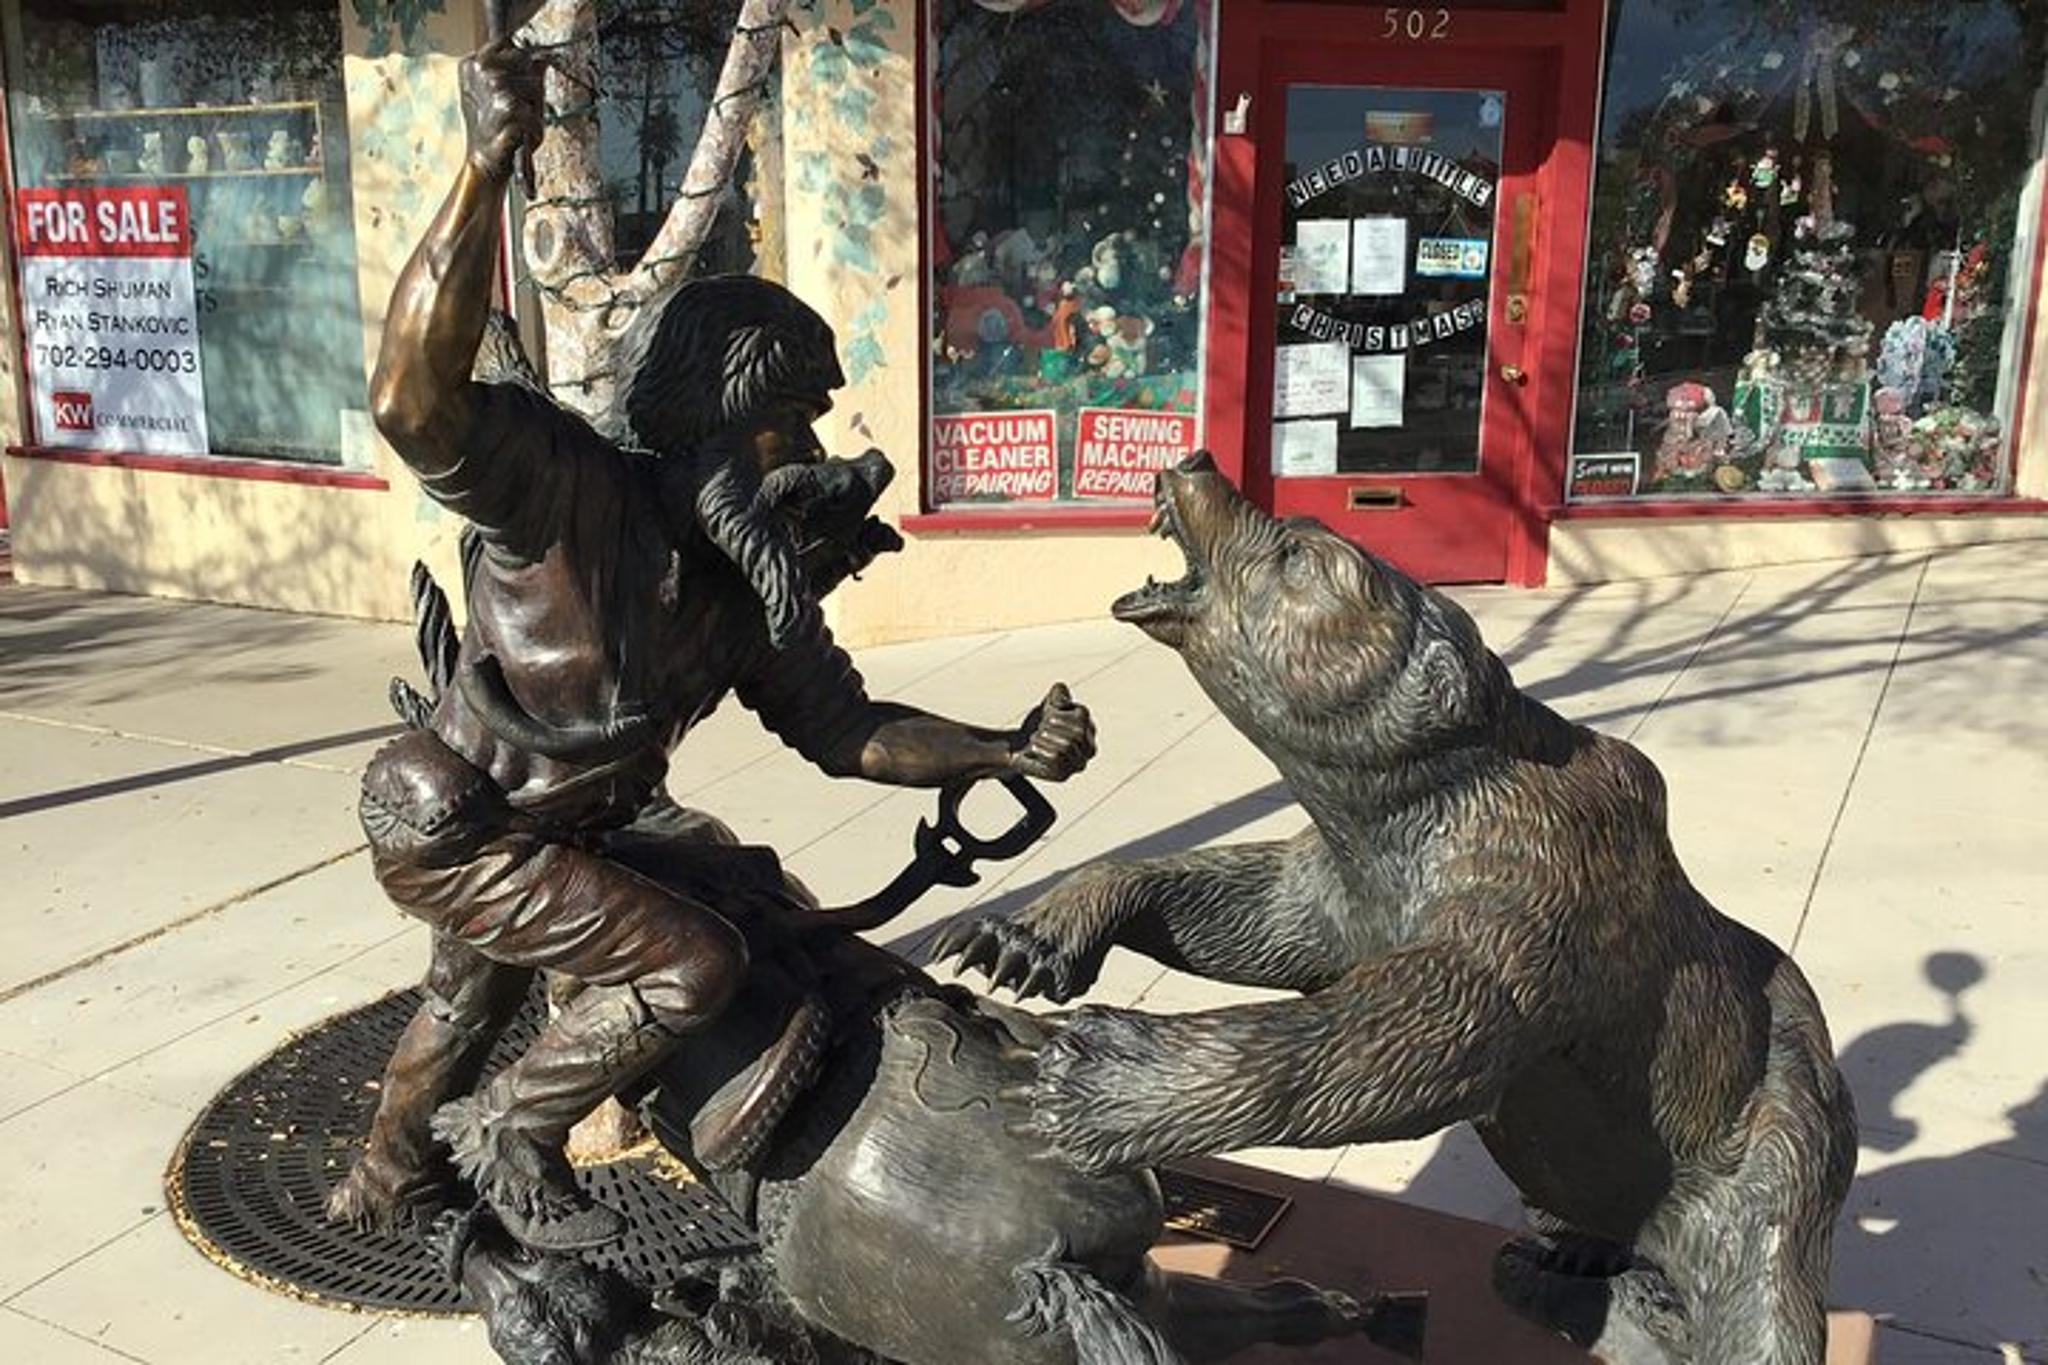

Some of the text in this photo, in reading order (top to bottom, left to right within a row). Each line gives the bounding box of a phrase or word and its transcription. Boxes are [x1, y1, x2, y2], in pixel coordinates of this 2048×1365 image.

[1380, 8, 1449, 38] 502
[1287, 152, 1362, 205] NEED
[27, 201, 89, 243] FOR
[97, 201, 180, 243] SALE
[46, 278, 171, 299] RICH SHUMAN
[36, 310, 189, 335] RYAN STANKOVIC
[36, 344, 197, 373] 702-294-0003
[56, 402, 91, 425] KW
[934, 419, 1048, 446] VACUUM
[1093, 415, 1183, 444] SEWING
[935, 446, 1050, 472] CLEANER
[1083, 441, 1189, 470] MACHINE
[934, 470, 1052, 497] REPAIRING
[1077, 469, 1155, 494] REPAIR
